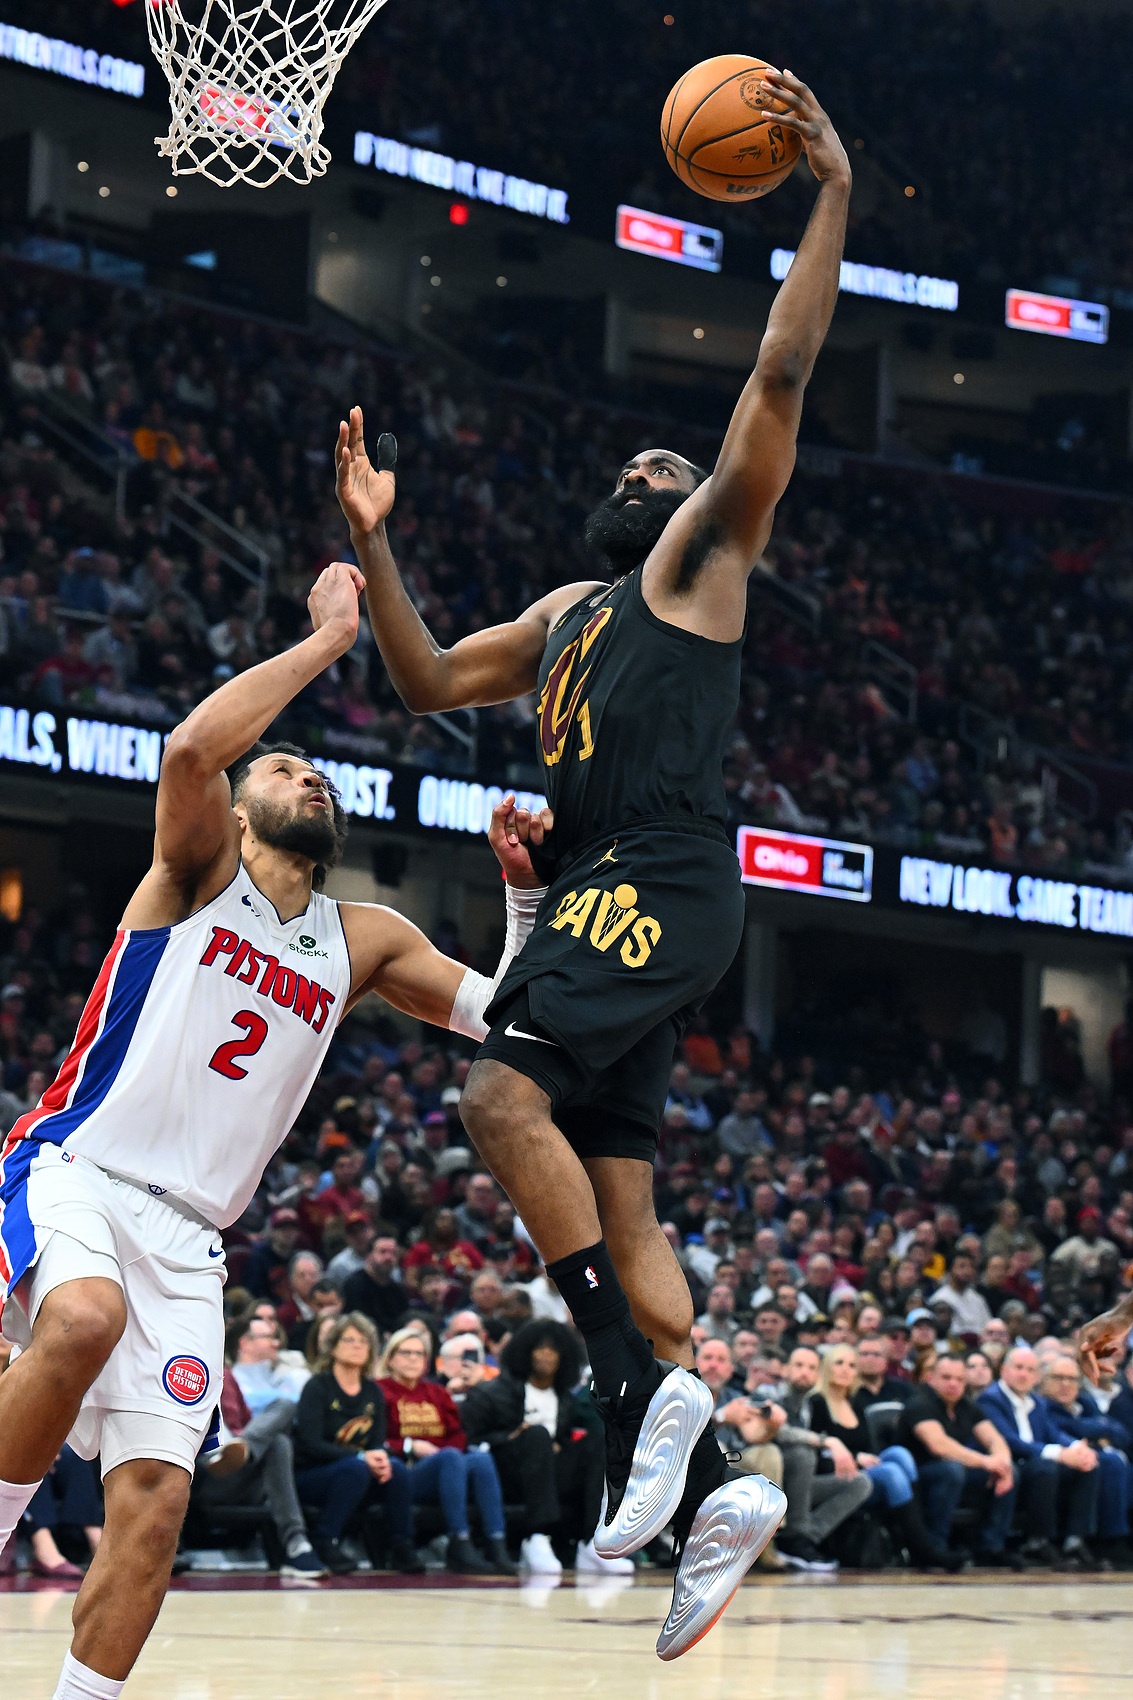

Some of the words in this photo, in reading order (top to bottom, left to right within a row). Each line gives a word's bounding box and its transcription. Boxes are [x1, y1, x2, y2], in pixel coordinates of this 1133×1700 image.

[67, 717, 161, 783] WHEN
[576, 699, 594, 761] 1
[547, 884, 662, 968] CAVS
[900, 856, 953, 907] NEW
[1015, 874, 1077, 928] SAME
[199, 926, 336, 1034] PISTONS
[208, 1009, 269, 1081] 2
[172, 1374, 201, 1393] PISTONS
[174, 1366, 203, 1384] DETROIT
